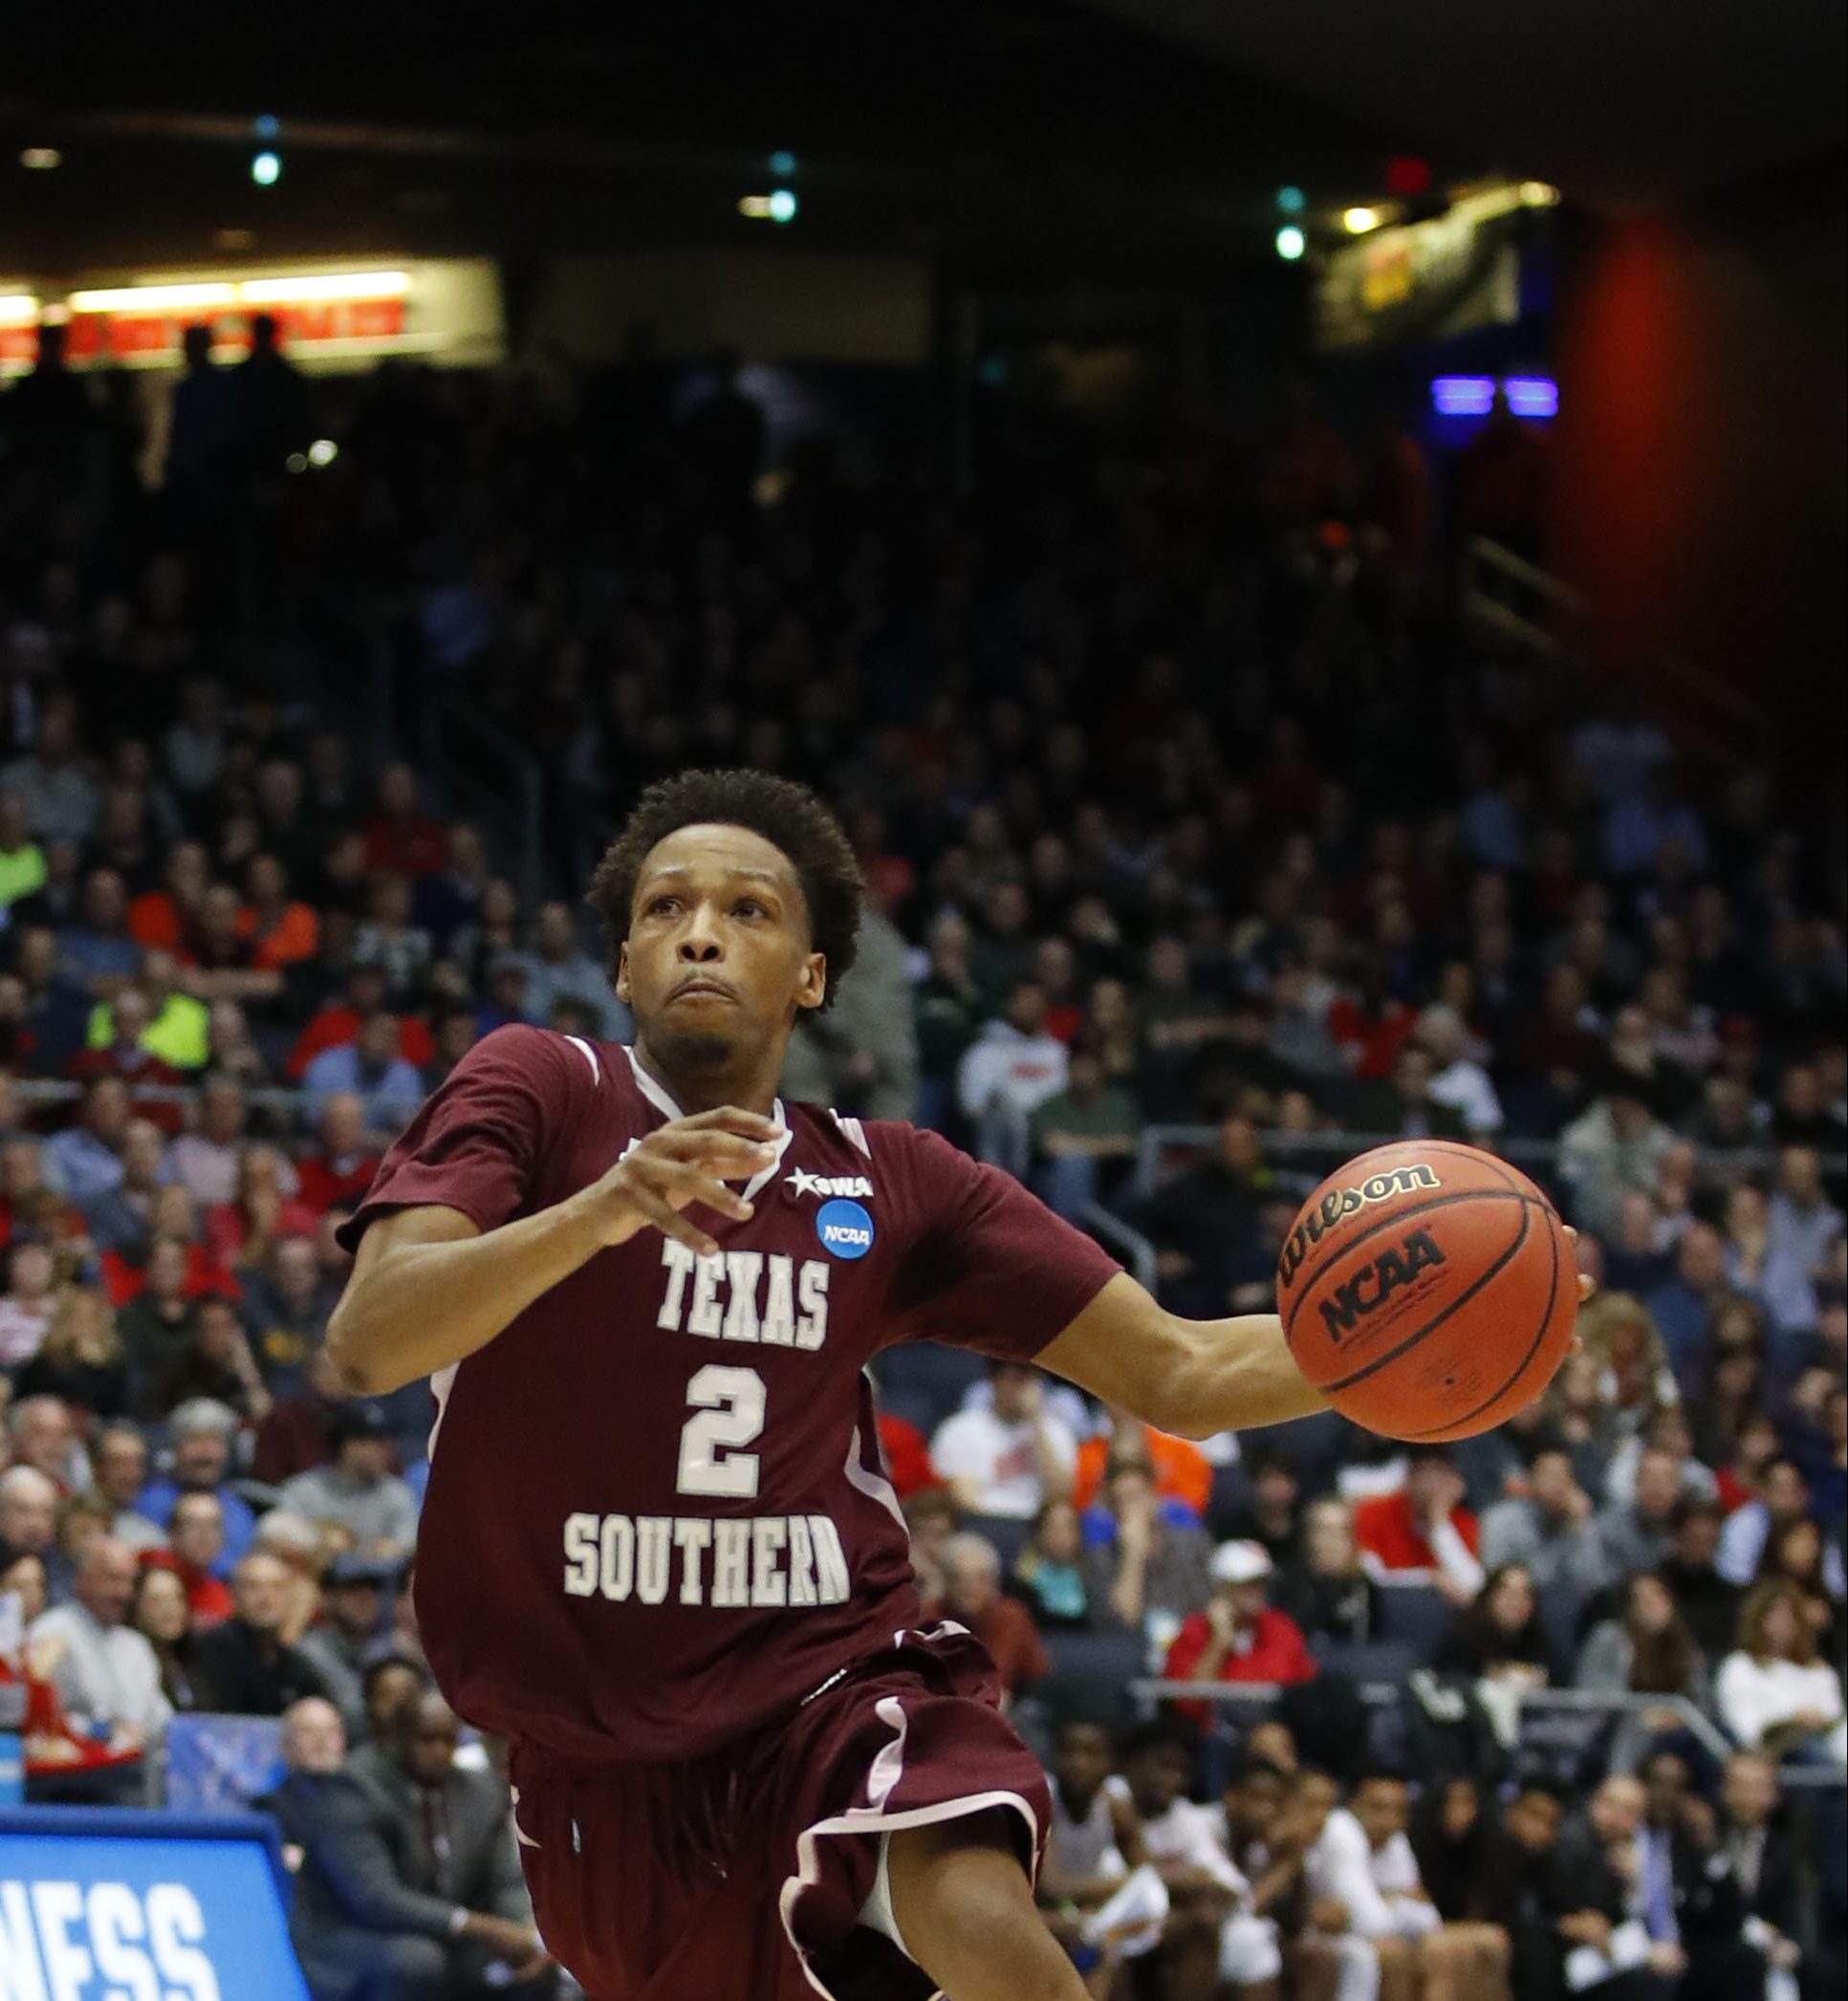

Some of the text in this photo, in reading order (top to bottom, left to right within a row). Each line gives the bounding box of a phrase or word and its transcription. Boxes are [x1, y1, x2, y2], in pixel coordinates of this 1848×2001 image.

[824, 1225, 871, 1246] NCAA
[1277, 1164, 1442, 1288] Wilson
[656, 1237, 830, 1352] TEXAS
[1317, 1228, 1446, 1343] NCAA
[676, 1363, 767, 1498] 2
[563, 1512, 851, 1607] SOUTHERN
